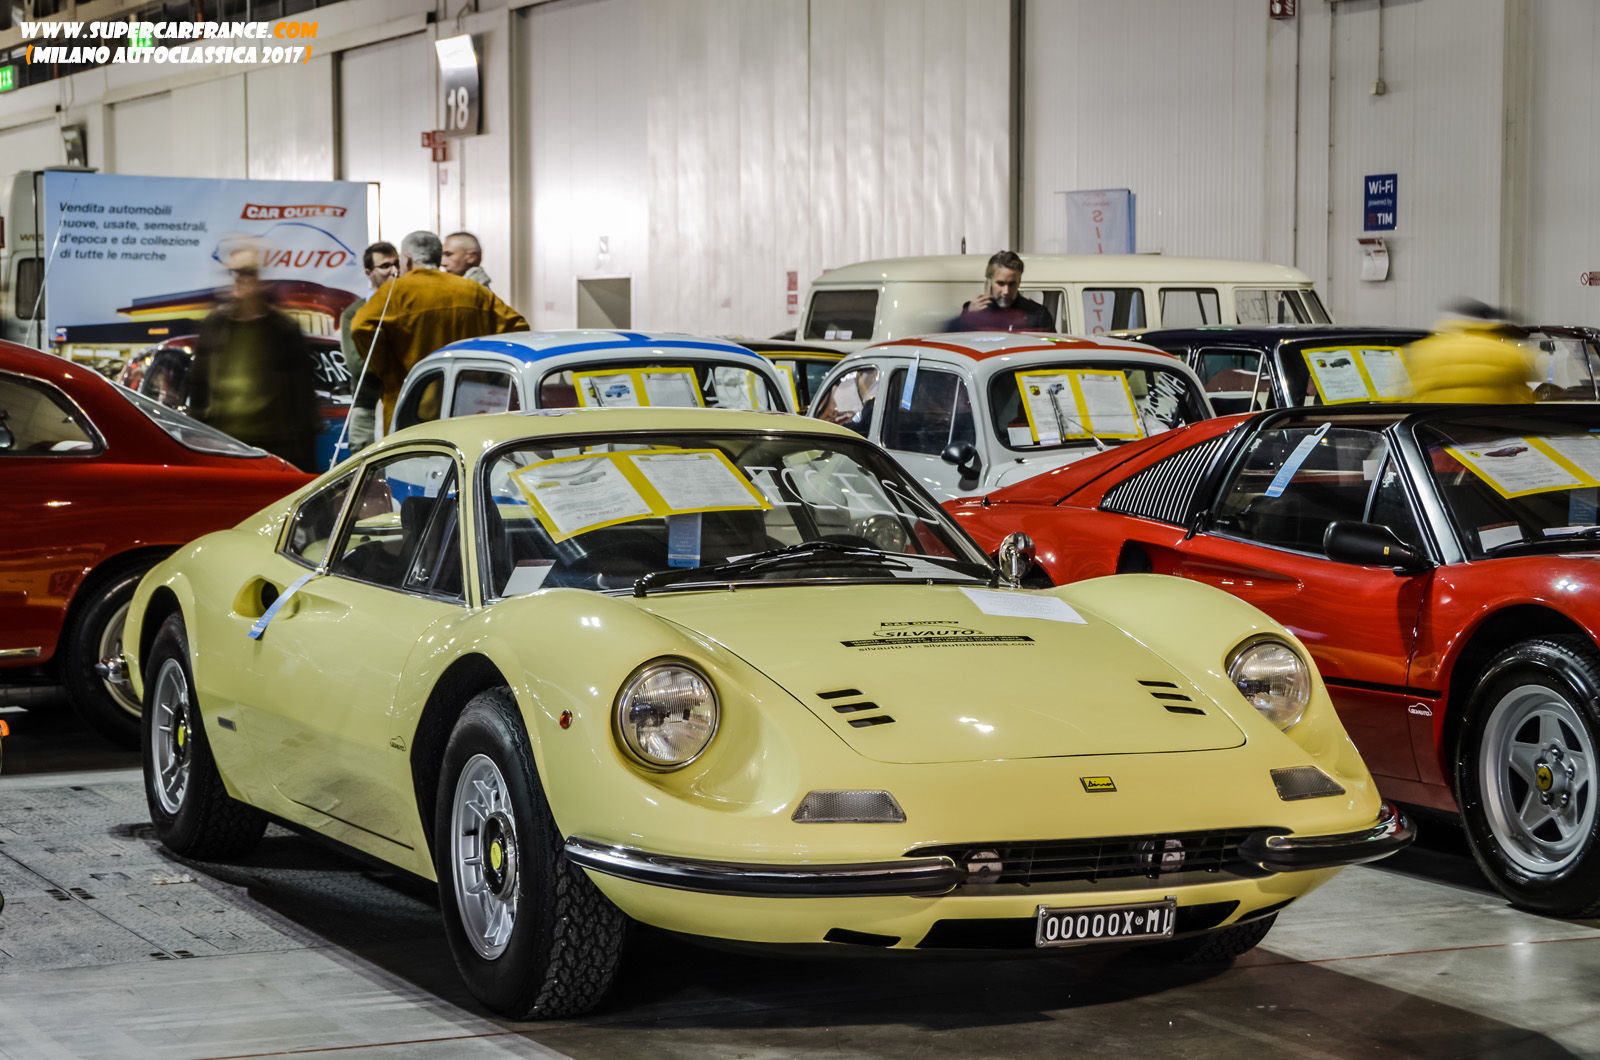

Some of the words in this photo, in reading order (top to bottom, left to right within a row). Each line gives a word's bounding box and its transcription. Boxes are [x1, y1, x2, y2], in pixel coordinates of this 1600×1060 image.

[447, 86, 469, 131] 18
[1368, 179, 1394, 195] Wi-Fi
[60, 202, 104, 214] Vendita
[108, 205, 173, 216] automobili
[1368, 199, 1386, 207] powered
[1386, 199, 1393, 207] by
[246, 206, 280, 218] CAR
[283, 206, 345, 218] OUTLET
[1377, 212, 1393, 225] TIM
[103, 220, 140, 231] usate,
[144, 221, 208, 232] semestrali,
[59, 233, 107, 246] d'epoca
[111, 236, 118, 244] e
[122, 235, 137, 245] da
[140, 236, 200, 247] collezione
[60, 249, 71, 259] di
[75, 249, 104, 260] tutte
[107, 250, 117, 260] le
[121, 251, 167, 262] marche
[886, 630, 975, 638] SILVAUTO
